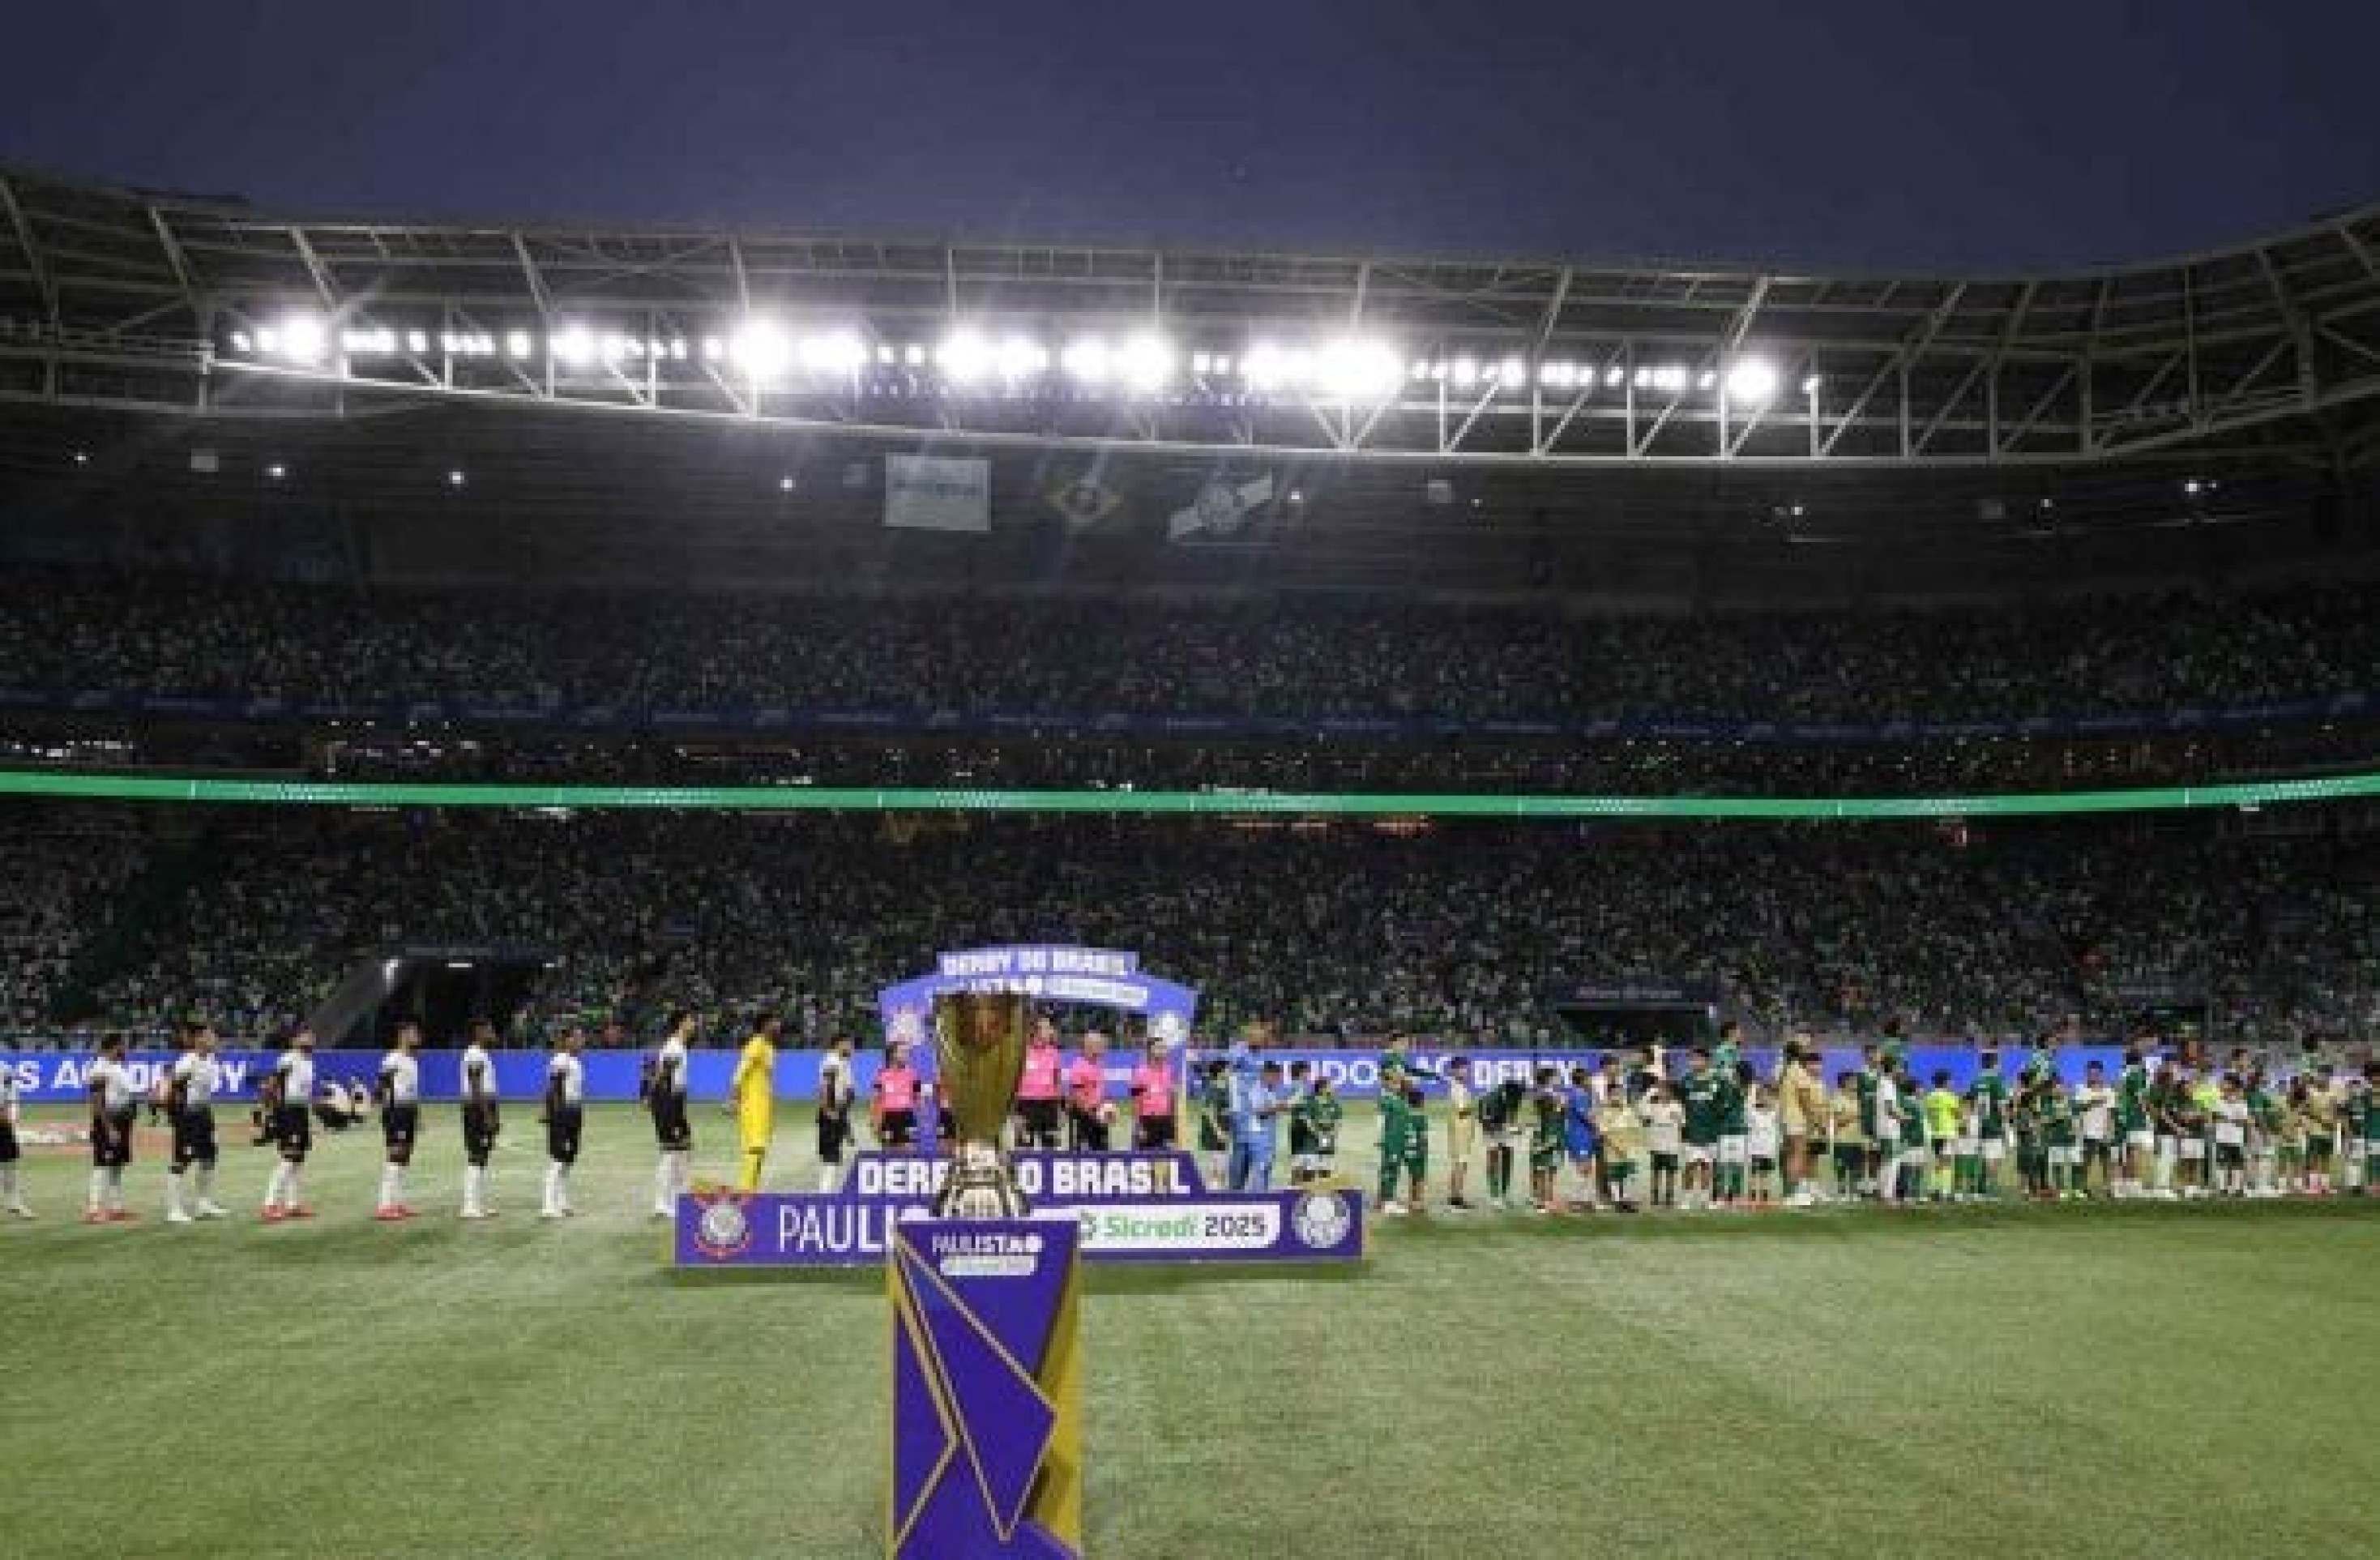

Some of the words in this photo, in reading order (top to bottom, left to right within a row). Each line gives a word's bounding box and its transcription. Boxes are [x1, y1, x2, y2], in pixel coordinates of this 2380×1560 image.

[1473, 1059, 1578, 1088] DERY
[857, 1160, 949, 1195] DER
[1053, 1158, 1191, 1195] BRASIL
[1205, 1216, 1266, 1237] 2025
